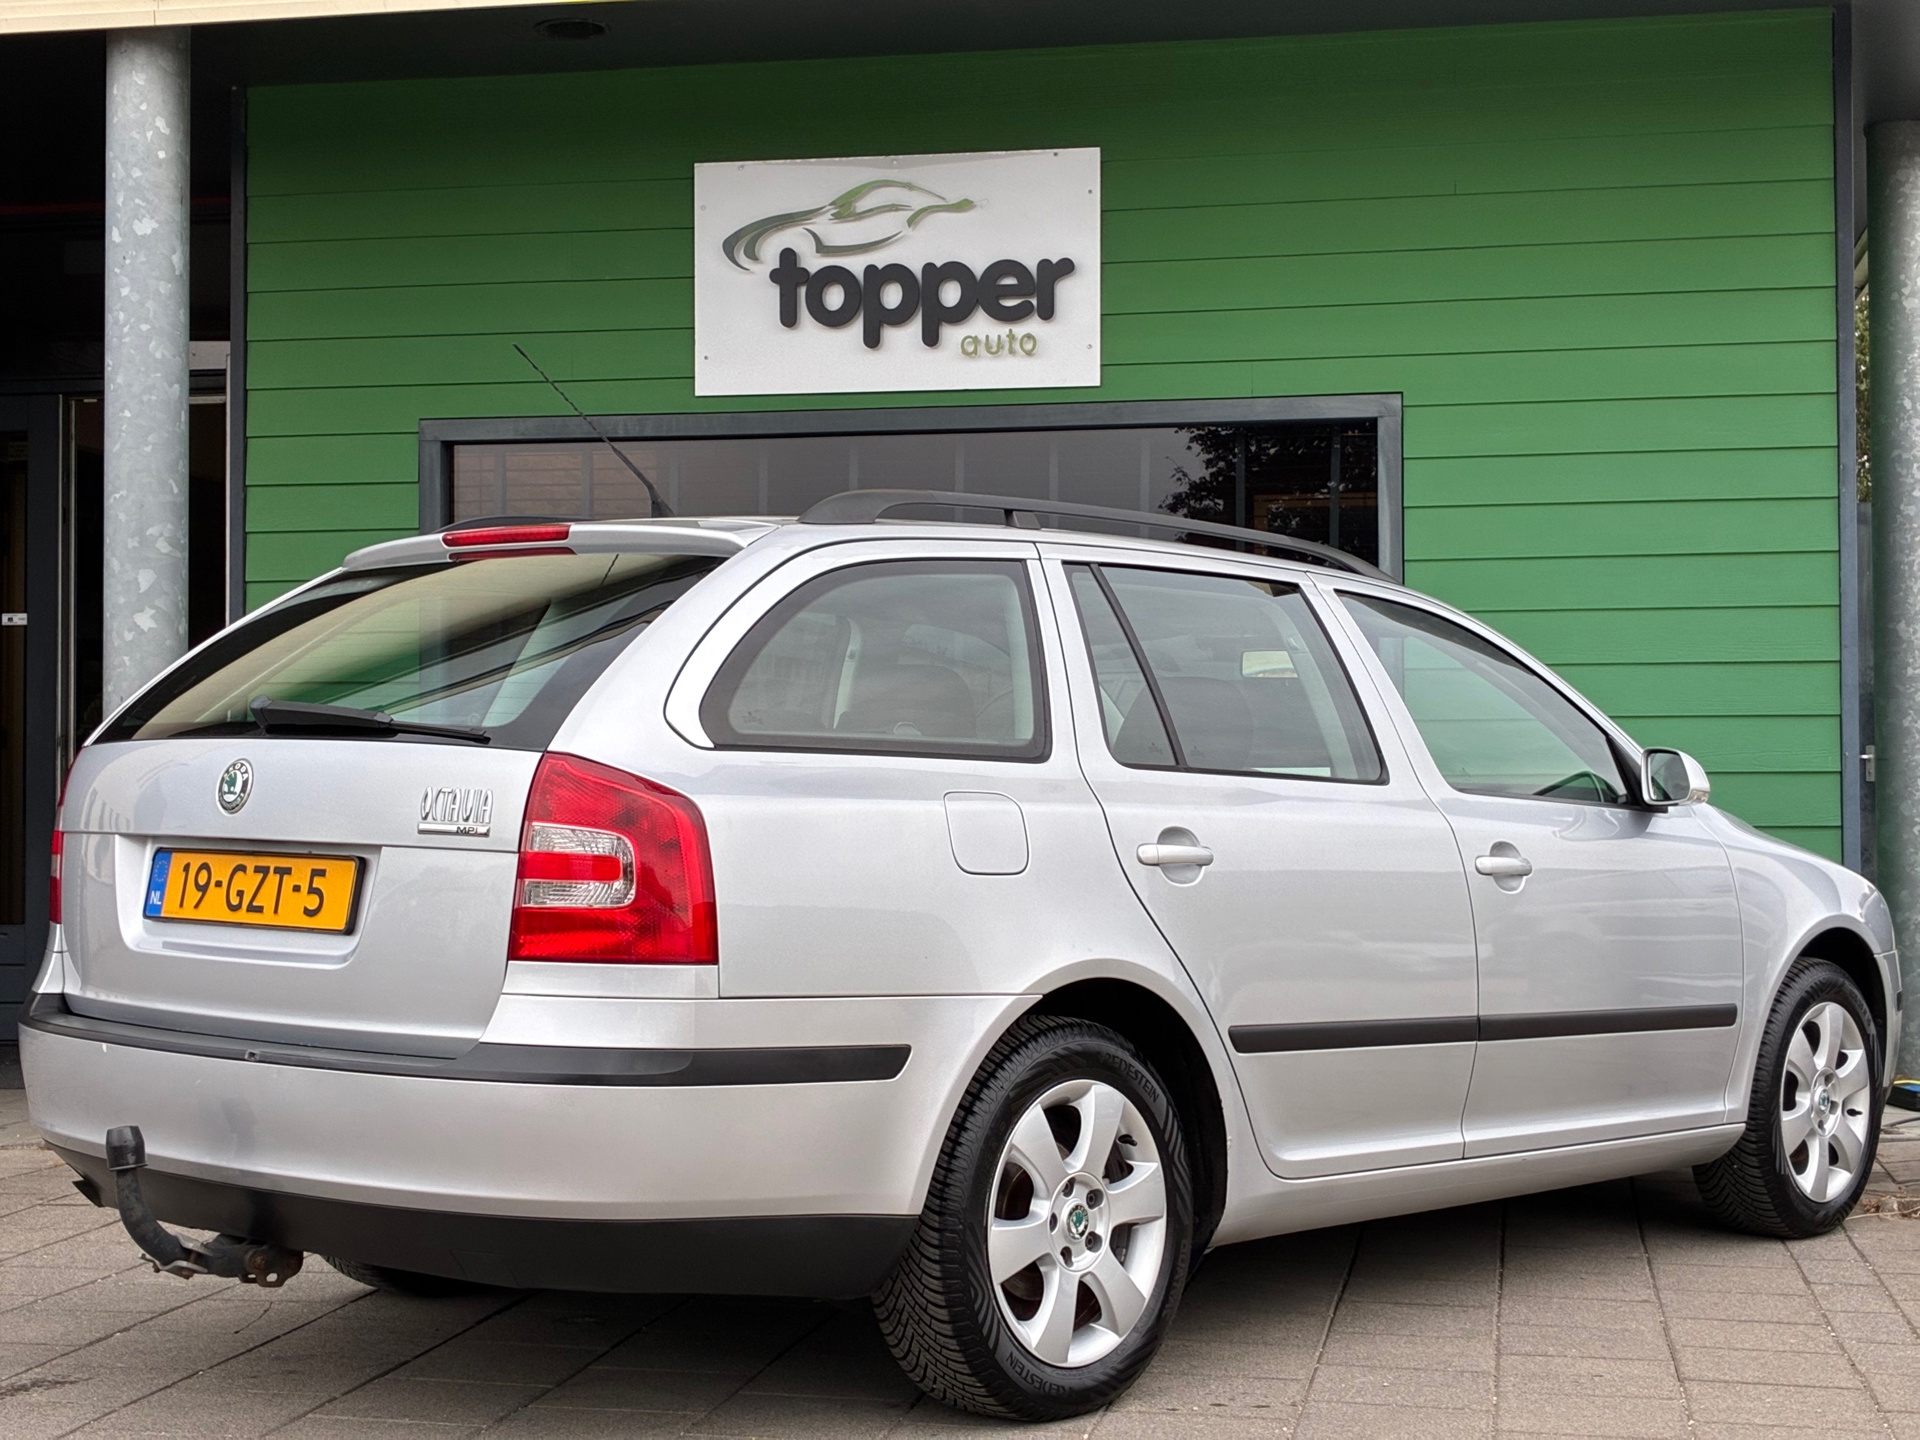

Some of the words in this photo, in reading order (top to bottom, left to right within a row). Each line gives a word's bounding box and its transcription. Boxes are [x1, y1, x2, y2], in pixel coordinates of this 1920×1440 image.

[769, 247, 1075, 349] topper
[960, 327, 1037, 358] auto
[420, 786, 494, 824] OCTAVIA
[149, 890, 162, 906] NL
[178, 861, 327, 917] 19-GZT-5
